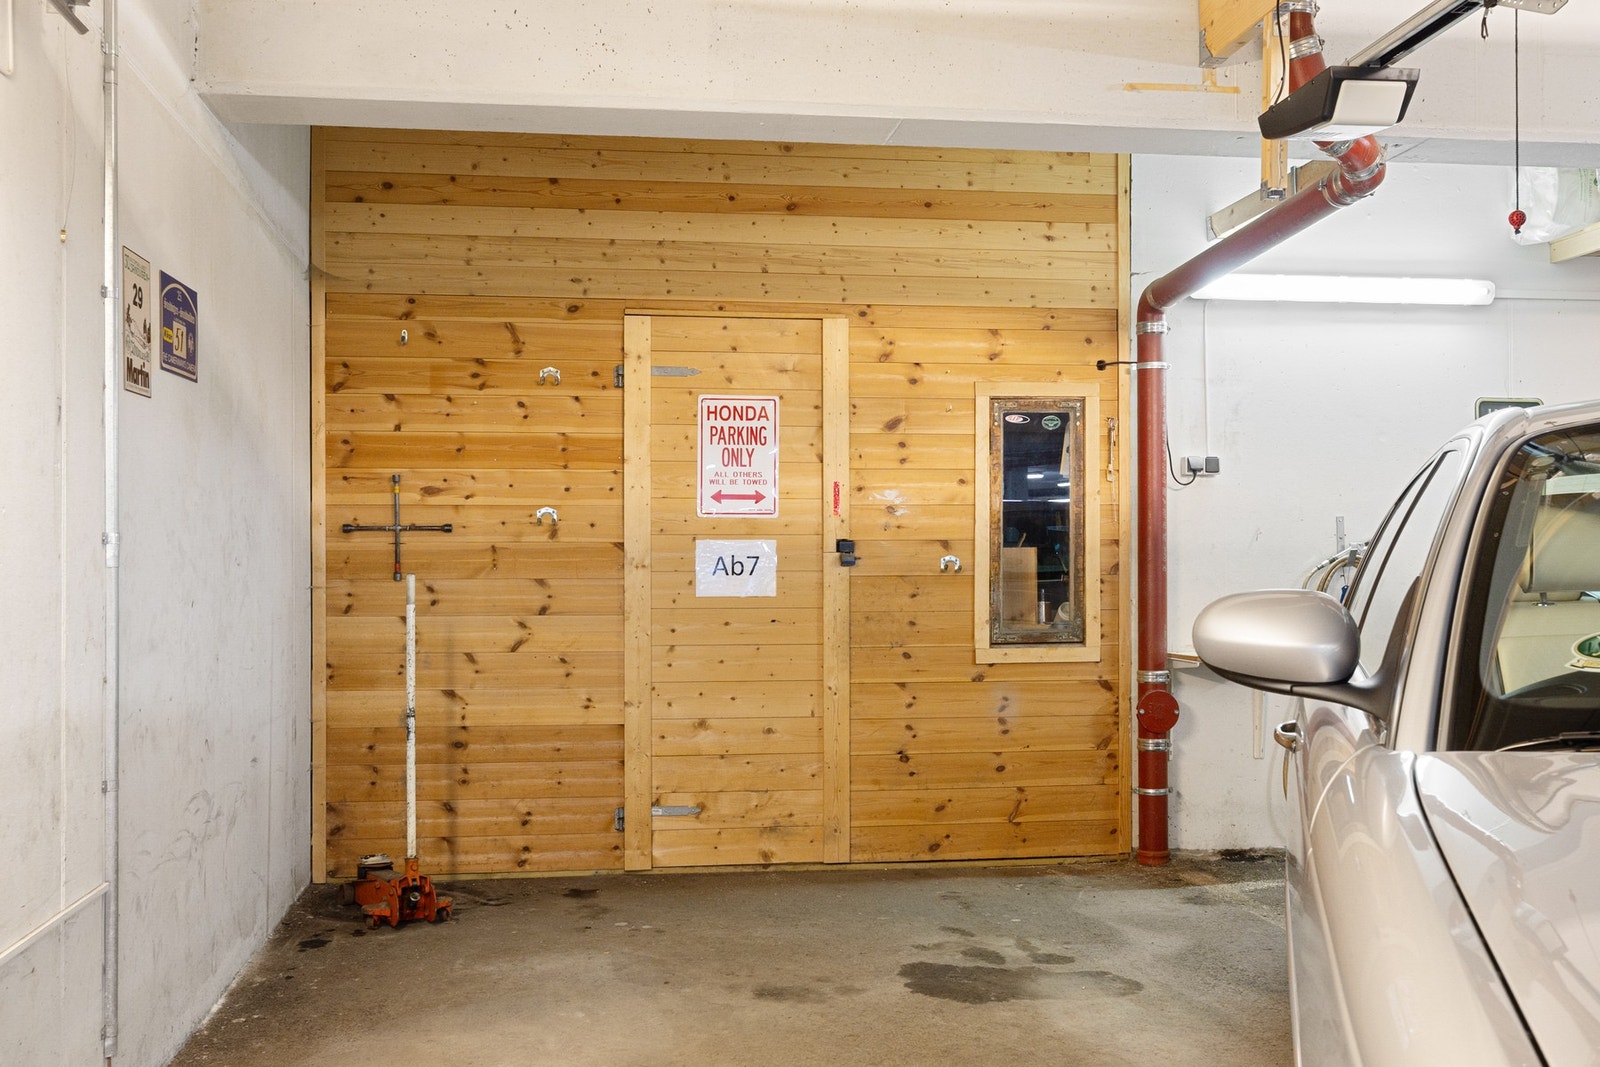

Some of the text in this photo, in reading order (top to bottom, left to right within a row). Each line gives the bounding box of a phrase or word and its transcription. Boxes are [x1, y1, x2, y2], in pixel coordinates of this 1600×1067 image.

[132, 283, 143, 310] 29
[126, 356, 150, 390] Martin
[706, 405, 769, 421] HONDA
[709, 425, 767, 446] PARKING
[721, 447, 755, 468] ONLY
[712, 554, 760, 576] Ab7
